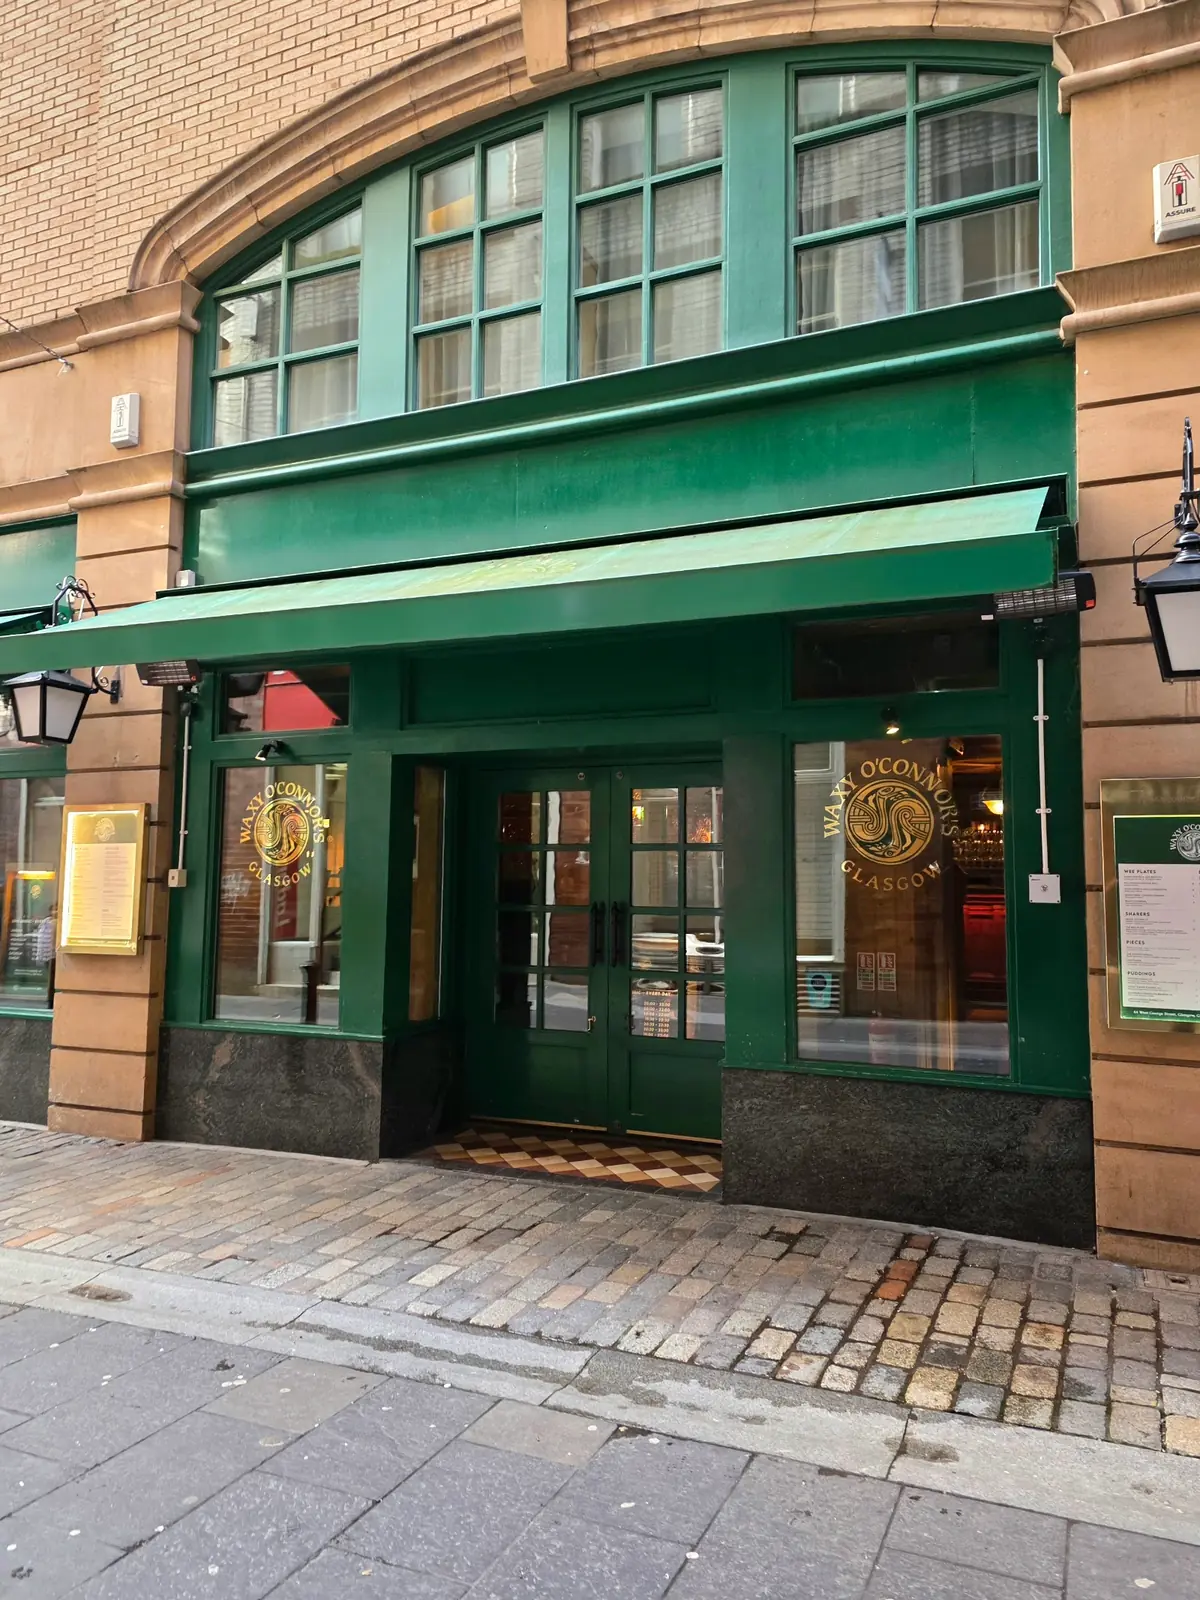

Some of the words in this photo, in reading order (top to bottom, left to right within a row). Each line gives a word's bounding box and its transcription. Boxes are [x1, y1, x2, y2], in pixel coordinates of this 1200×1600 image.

[1165, 206, 1196, 217] ASSURE
[823, 772, 858, 838] WAXY
[860, 757, 960, 836] O'CONNOR'S
[240, 792, 264, 843] WAXY
[265, 781, 325, 843] O'CONNOR'S
[1169, 828, 1183, 850] WAXY
[248, 862, 312, 887] GLASGOW
[841, 860, 941, 891] GLASGOW
